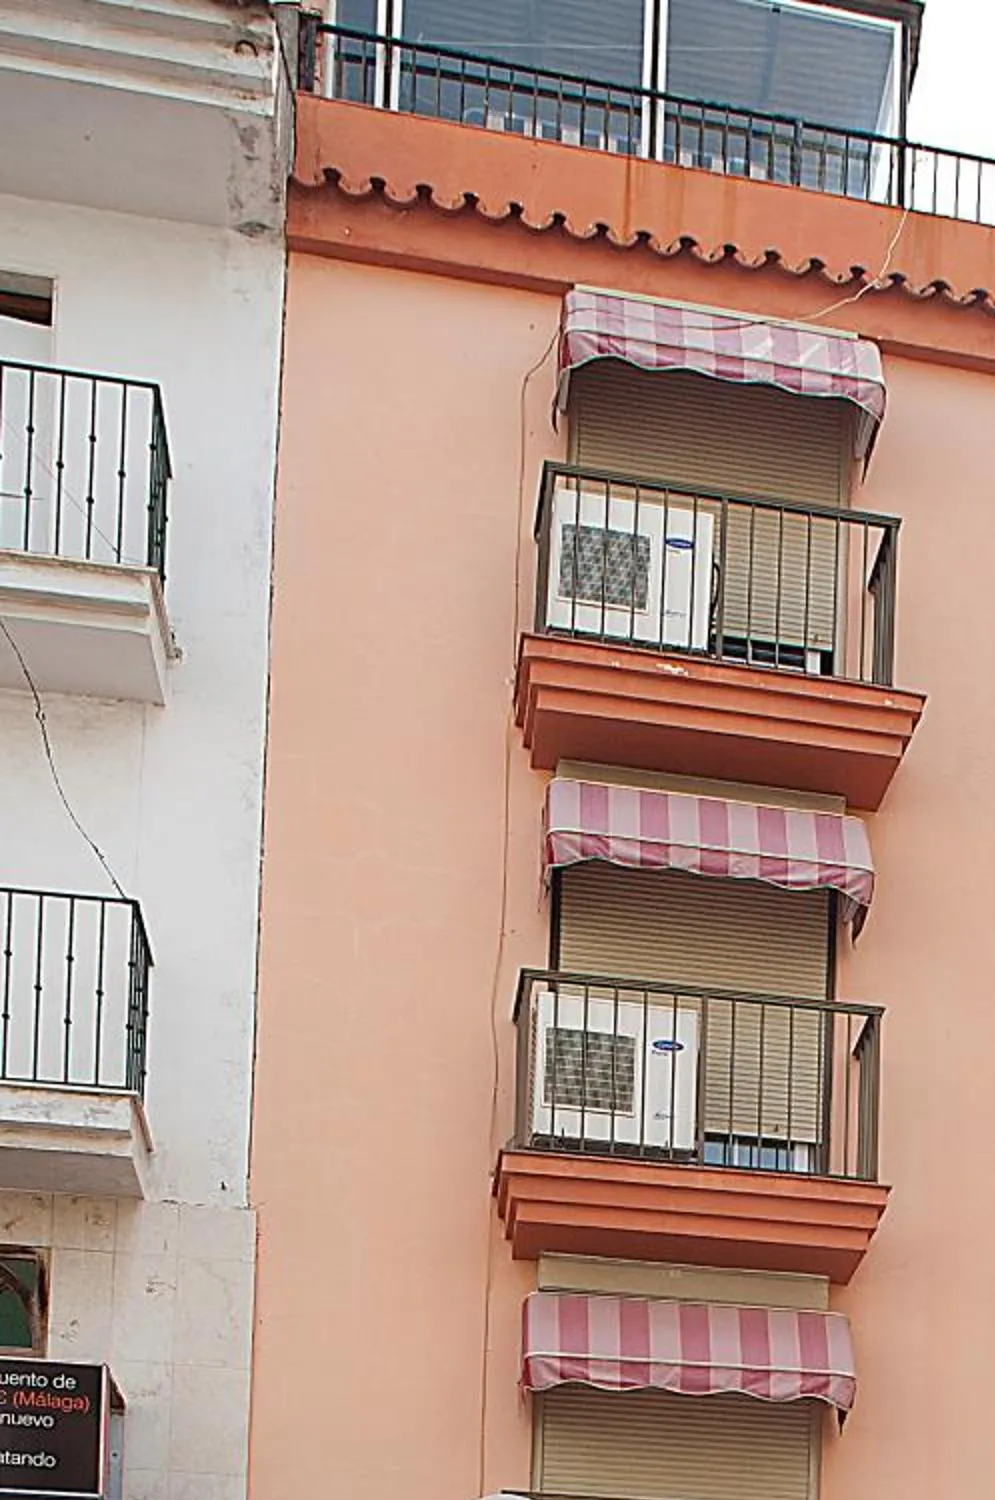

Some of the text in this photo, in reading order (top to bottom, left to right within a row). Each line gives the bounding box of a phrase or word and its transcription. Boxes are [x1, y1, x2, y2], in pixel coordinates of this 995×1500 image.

[52, 1373, 77, 1389] de
[13, 1391, 90, 1415] (Málaga)
[0, 1412, 54, 1427] nuevo
